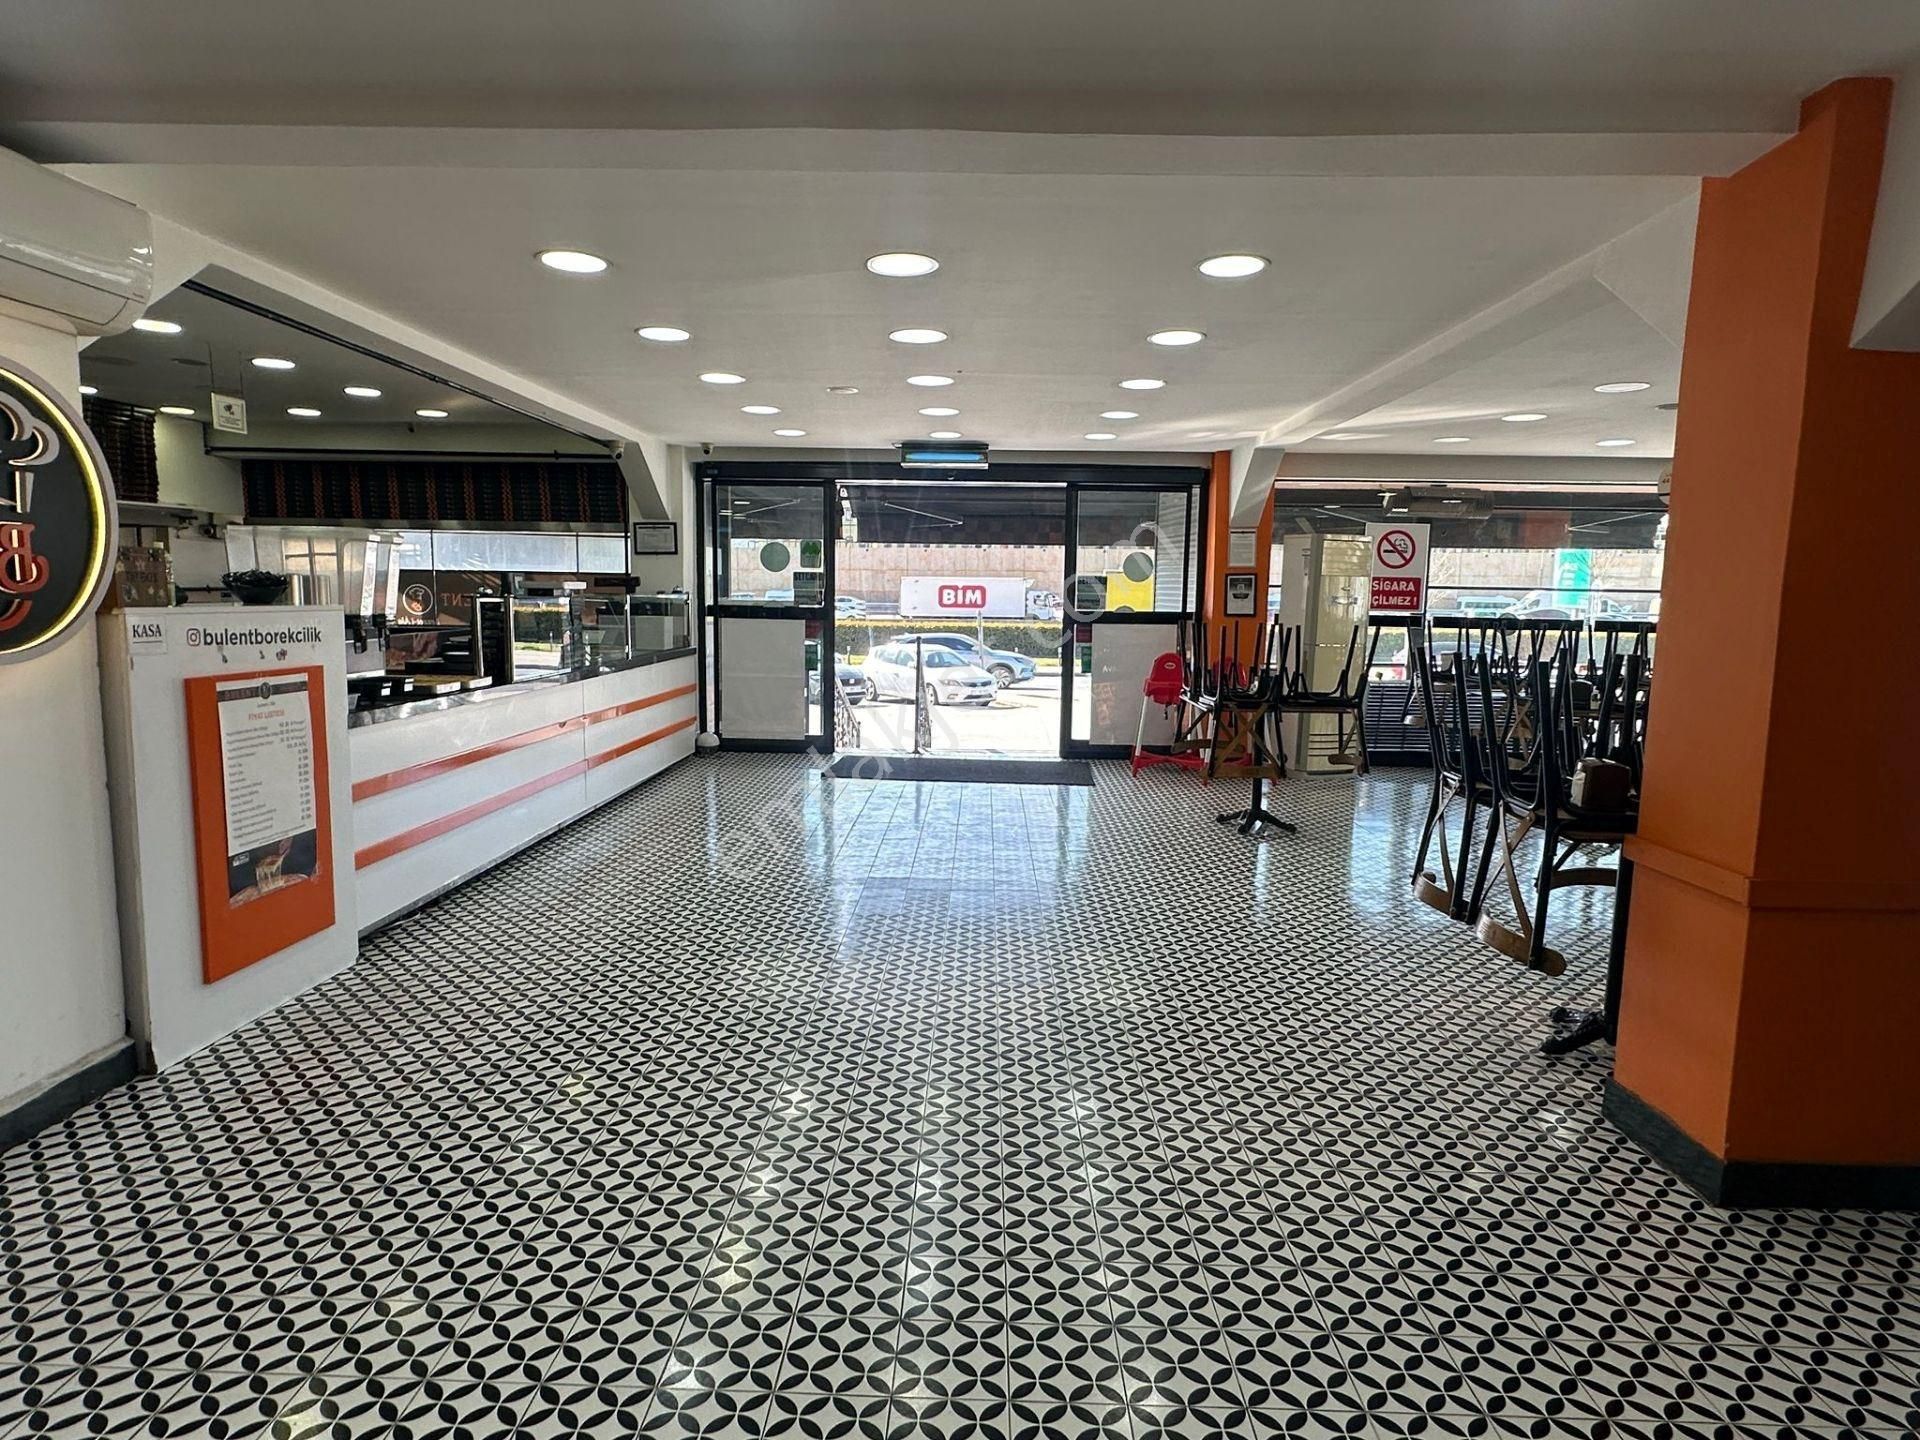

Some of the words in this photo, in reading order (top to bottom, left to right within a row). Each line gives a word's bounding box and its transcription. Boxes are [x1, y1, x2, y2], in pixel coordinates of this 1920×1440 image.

[1372, 578, 1415, 591] SİGARA
[133, 624, 162, 638] KASA
[203, 627, 321, 645] bulentborekcilik
